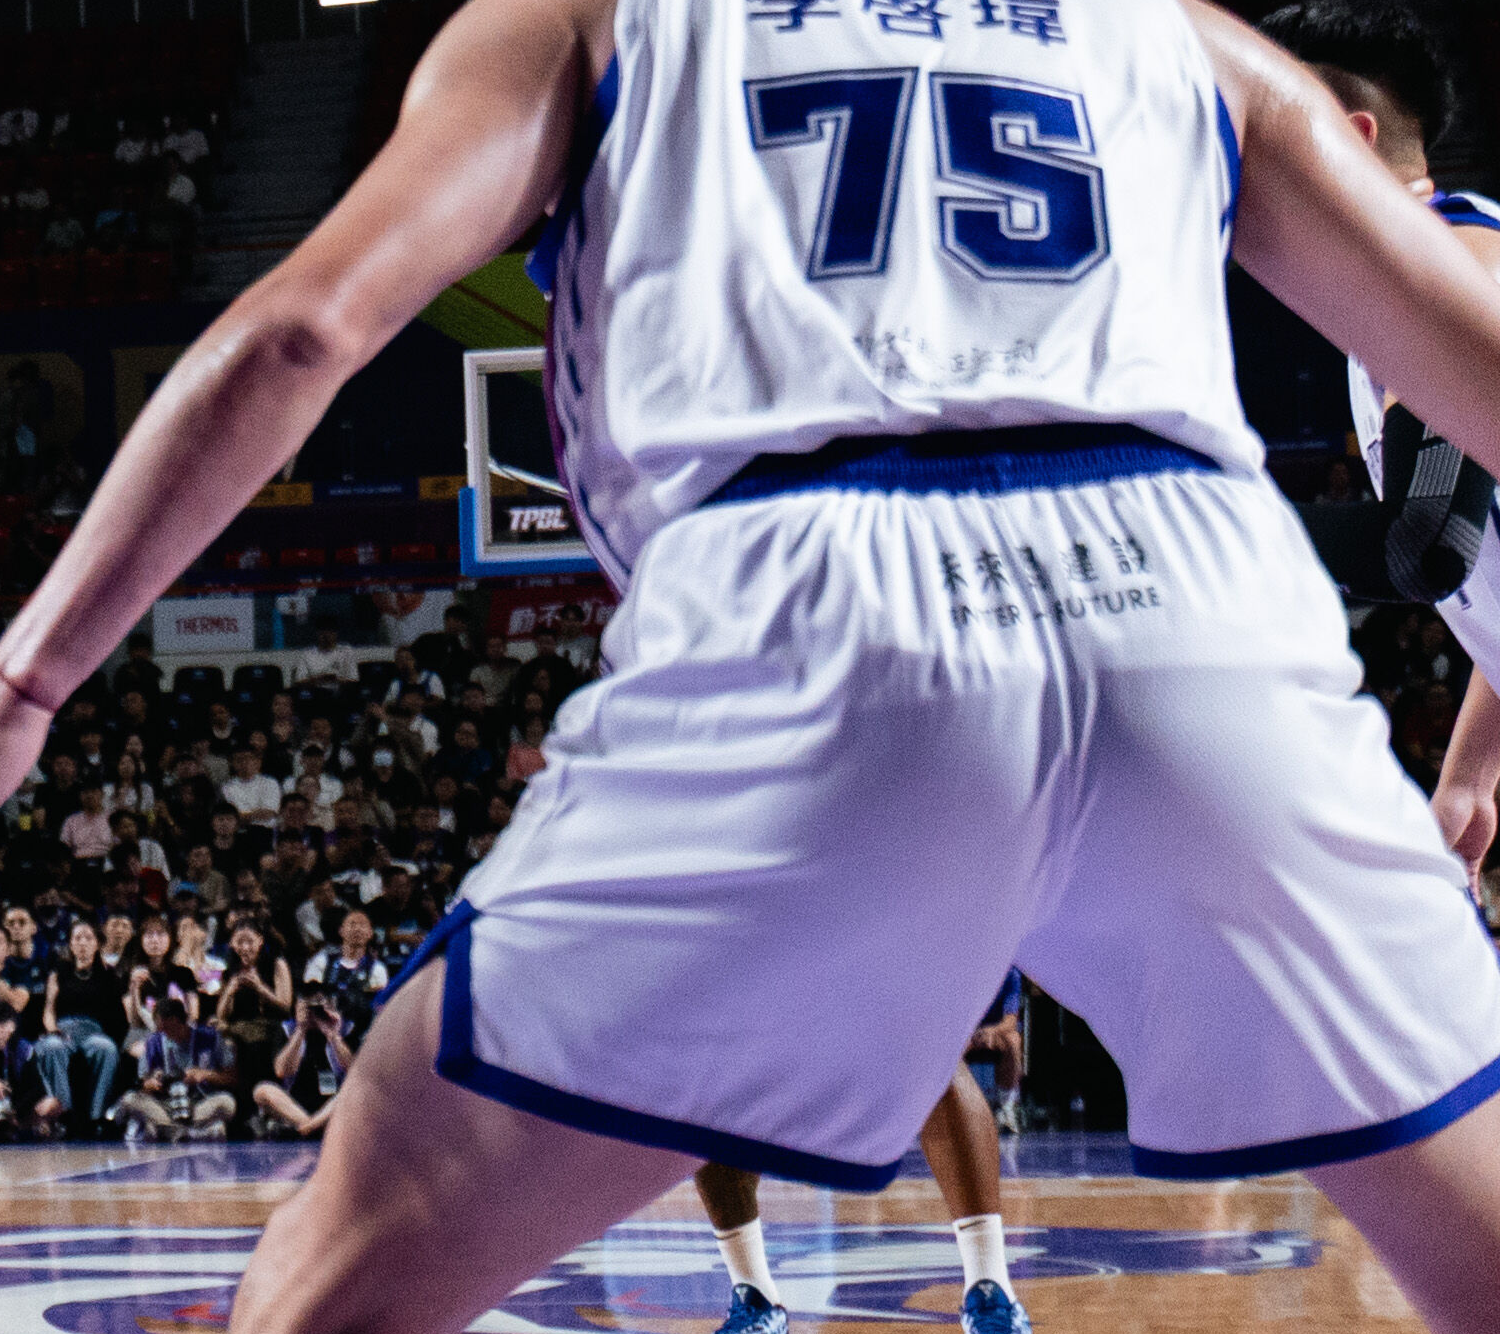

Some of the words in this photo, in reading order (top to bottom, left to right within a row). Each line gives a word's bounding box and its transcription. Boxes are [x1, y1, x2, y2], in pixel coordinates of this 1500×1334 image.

[743, 67, 1109, 285] 75
[505, 505, 568, 531] TPBL
[175, 616, 240, 636] THERMOS
